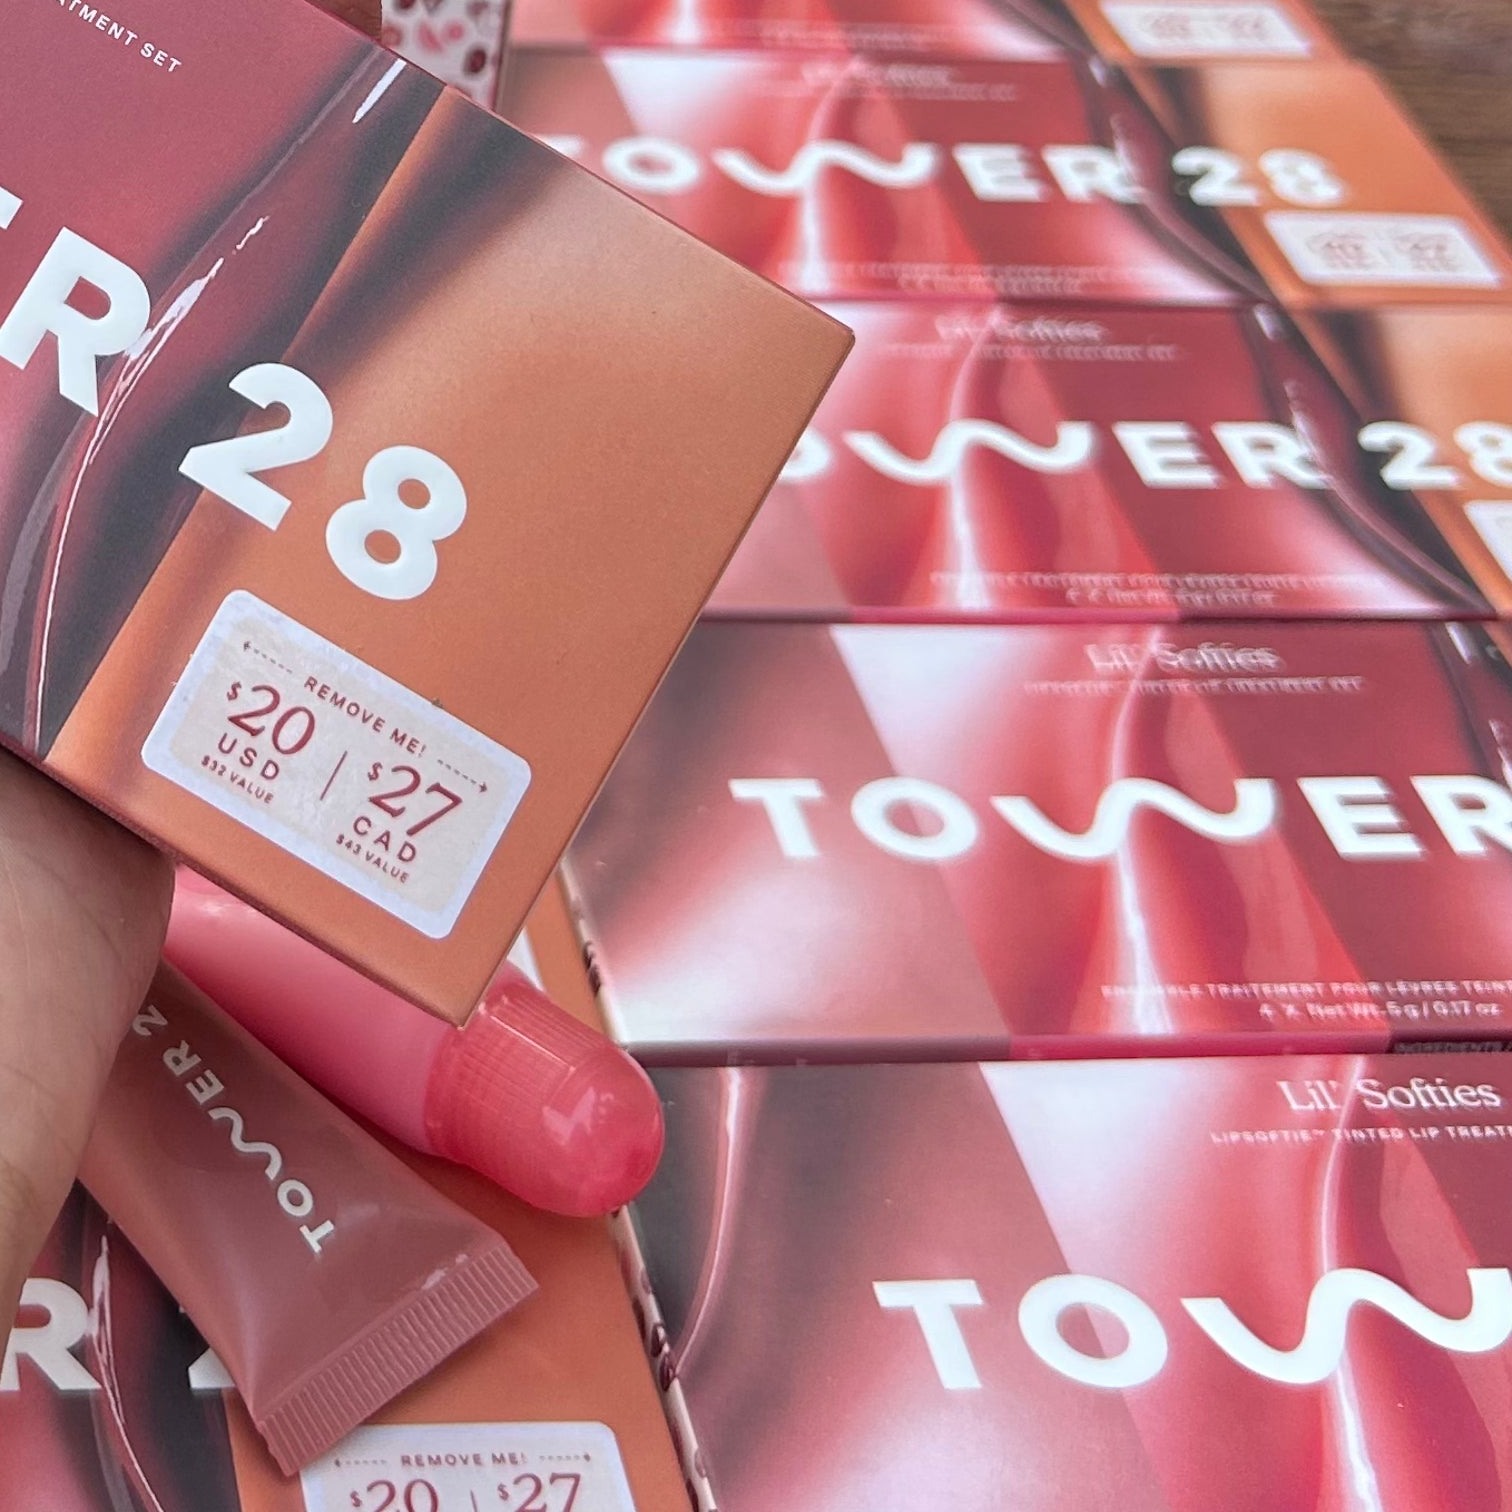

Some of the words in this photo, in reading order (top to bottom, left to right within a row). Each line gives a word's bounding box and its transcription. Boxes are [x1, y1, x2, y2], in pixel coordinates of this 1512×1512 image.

[139, 41, 183, 74] SET
[537, 135, 1142, 205] OWER
[1172, 145, 1346, 208] 28
[1357, 420, 1512, 490] 28
[179, 363, 467, 600] 28
[226, 681, 316, 756] $20
[303, 676, 386, 733] REMOVE
[389, 728, 428, 758] ME!
[201, 755, 227, 776] $32
[229, 770, 275, 804] VALUE
[217, 731, 281, 781] USD
[367, 761, 464, 838] $27
[729, 774, 1512, 862] TOWER
[335, 834, 363, 855] $43
[364, 848, 410, 884] VALUE
[352, 815, 418, 864] CAD
[133, 1004, 168, 1036] 2
[1355, 1077, 1502, 1111] Softies
[162, 1040, 335, 1254] TOWER
[1330, 1127, 1404, 1142] TINTED
[1408, 1126, 1440, 1141] LIP
[872, 1267, 1512, 1389] TOW
[400, 1453, 485, 1467] REMOVE
[349, 1478, 440, 1512] $20
[497, 1472, 582, 1512] $27
